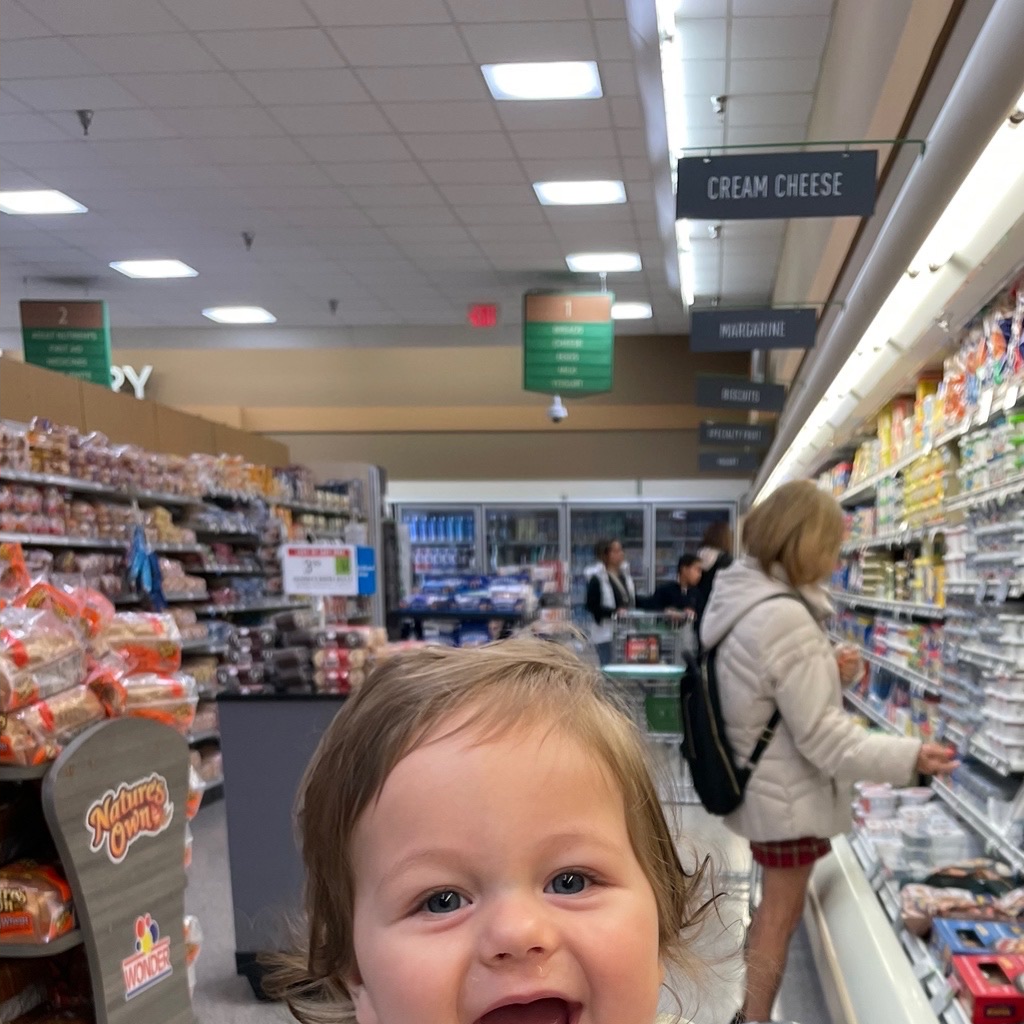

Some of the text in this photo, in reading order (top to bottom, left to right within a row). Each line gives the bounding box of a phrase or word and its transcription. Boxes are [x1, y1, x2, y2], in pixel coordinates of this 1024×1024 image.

[707, 171, 844, 200] CREAM CHEESE
[58, 306, 68, 325] 2
[719, 321, 786, 338] MARGARINE
[721, 388, 761, 403] BISCUITS
[87, 777, 166, 848] Nature's
[110, 804, 155, 859] Own
[123, 945, 171, 992] WONDER
